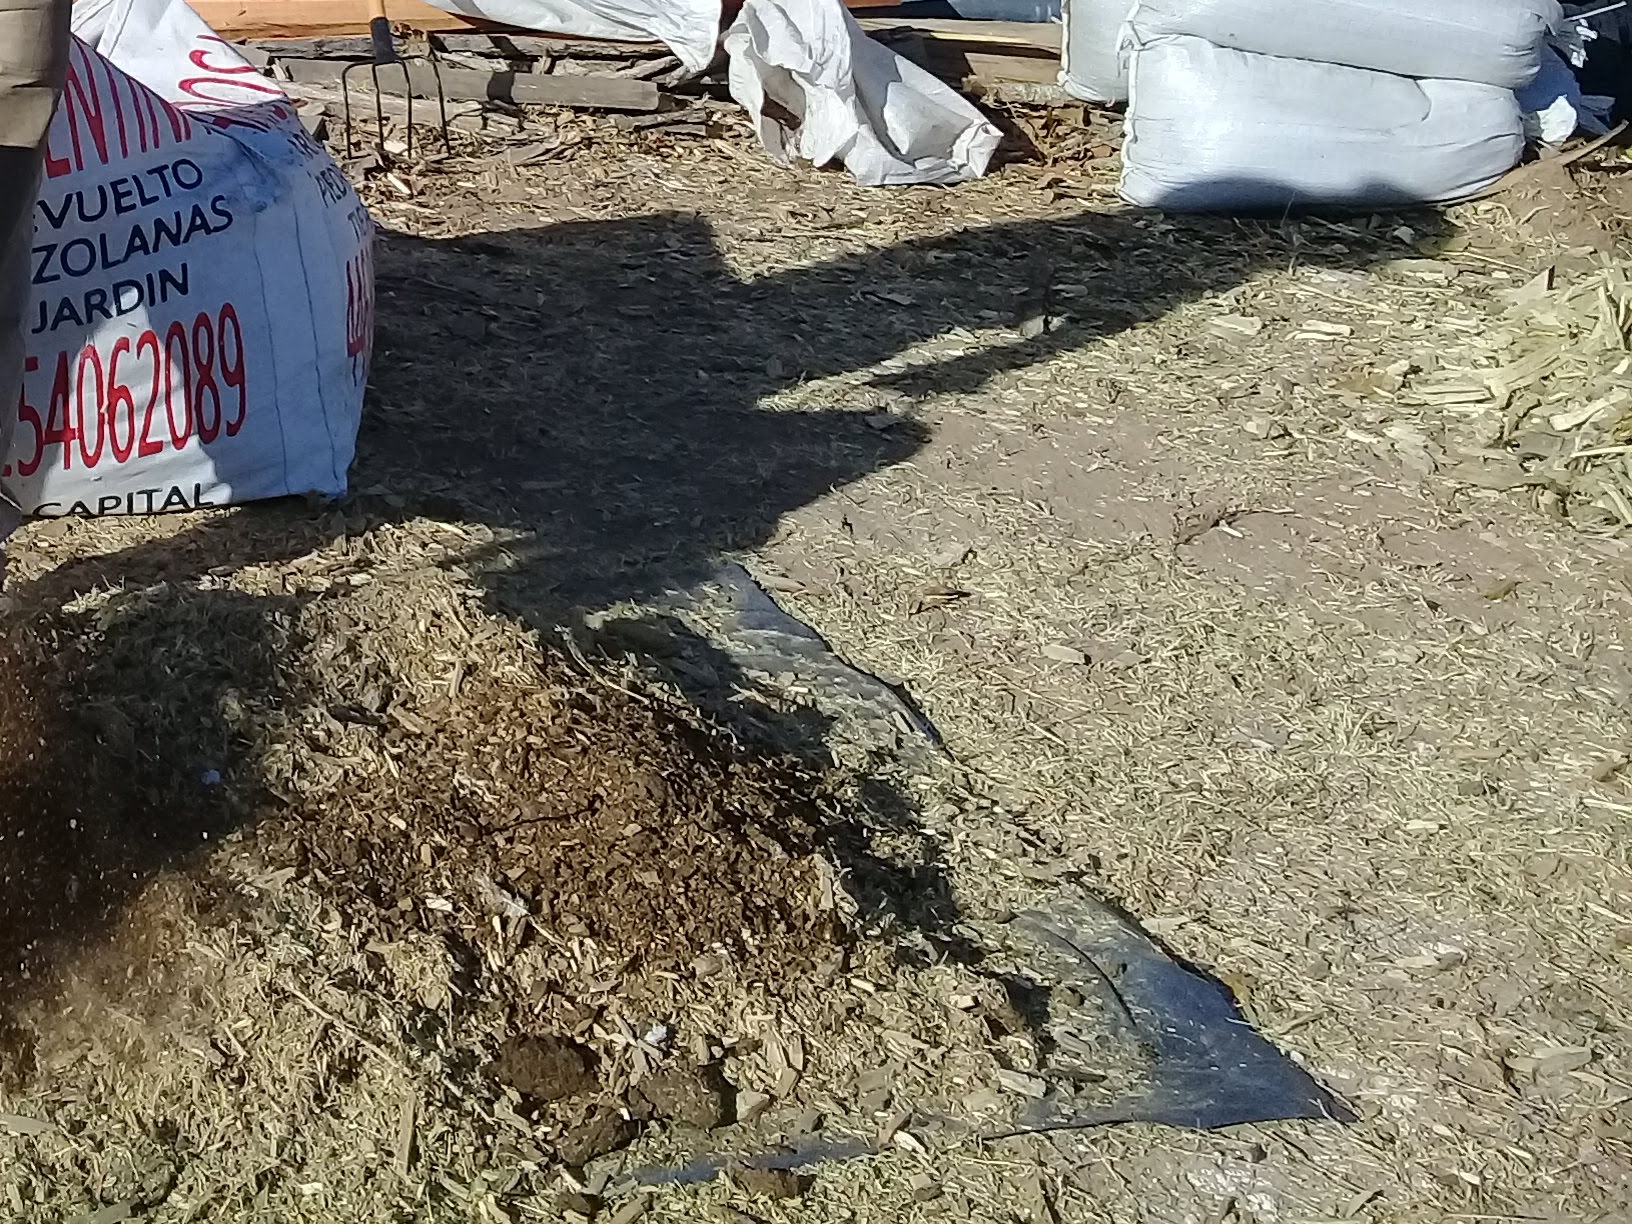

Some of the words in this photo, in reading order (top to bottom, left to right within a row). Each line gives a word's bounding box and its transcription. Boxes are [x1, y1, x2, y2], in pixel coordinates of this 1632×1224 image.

[32, 158, 203, 233] VUELTO
[31, 262, 189, 335] JARDIN
[32, 482, 214, 519] CAPITAL
